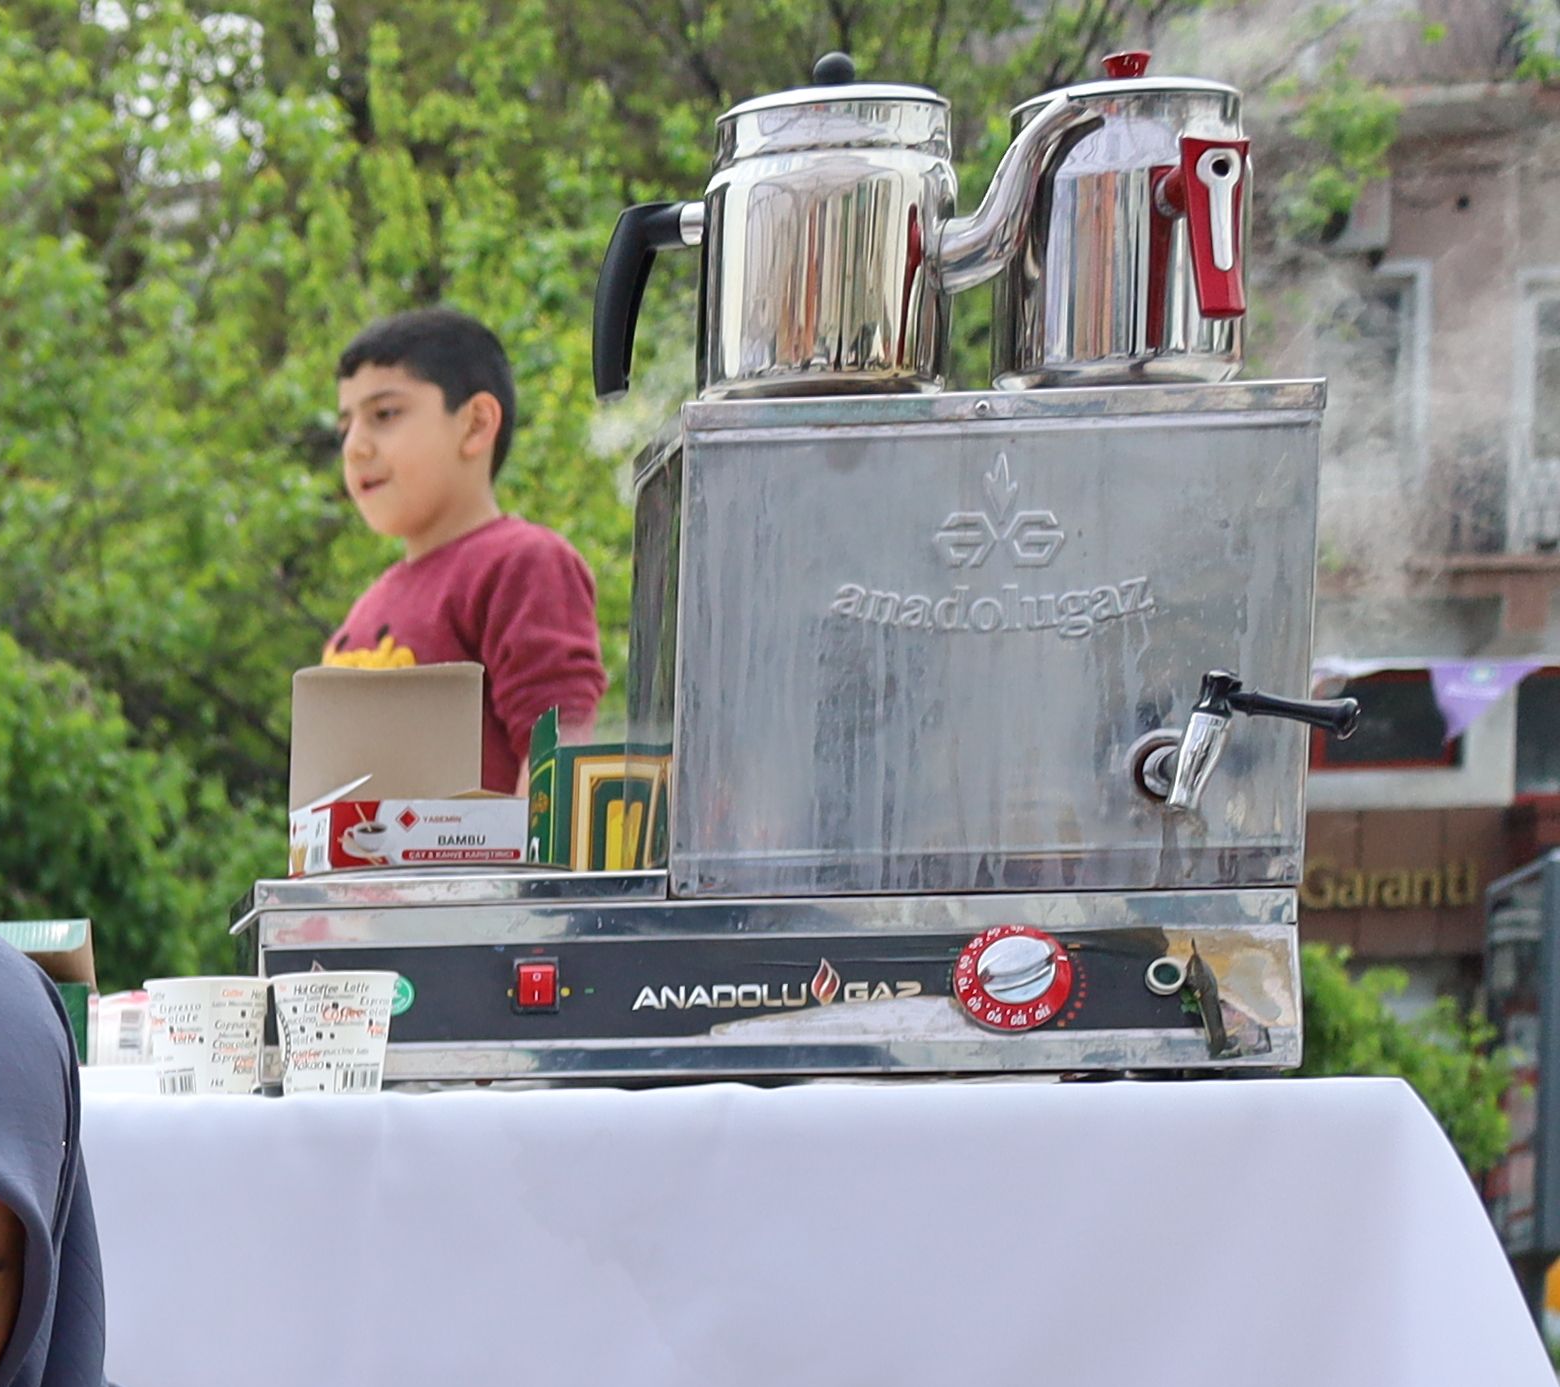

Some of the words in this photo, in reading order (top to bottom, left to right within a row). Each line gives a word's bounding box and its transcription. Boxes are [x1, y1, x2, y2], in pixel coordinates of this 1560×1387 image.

[830, 575, 1156, 639] anadolugaz
[438, 835, 486, 846] BAMBU
[435, 851, 463, 860] KAHVE
[1302, 857, 1477, 909] Garanti
[309, 984, 339, 996] Coffee
[632, 980, 808, 1011] ANADOLU
